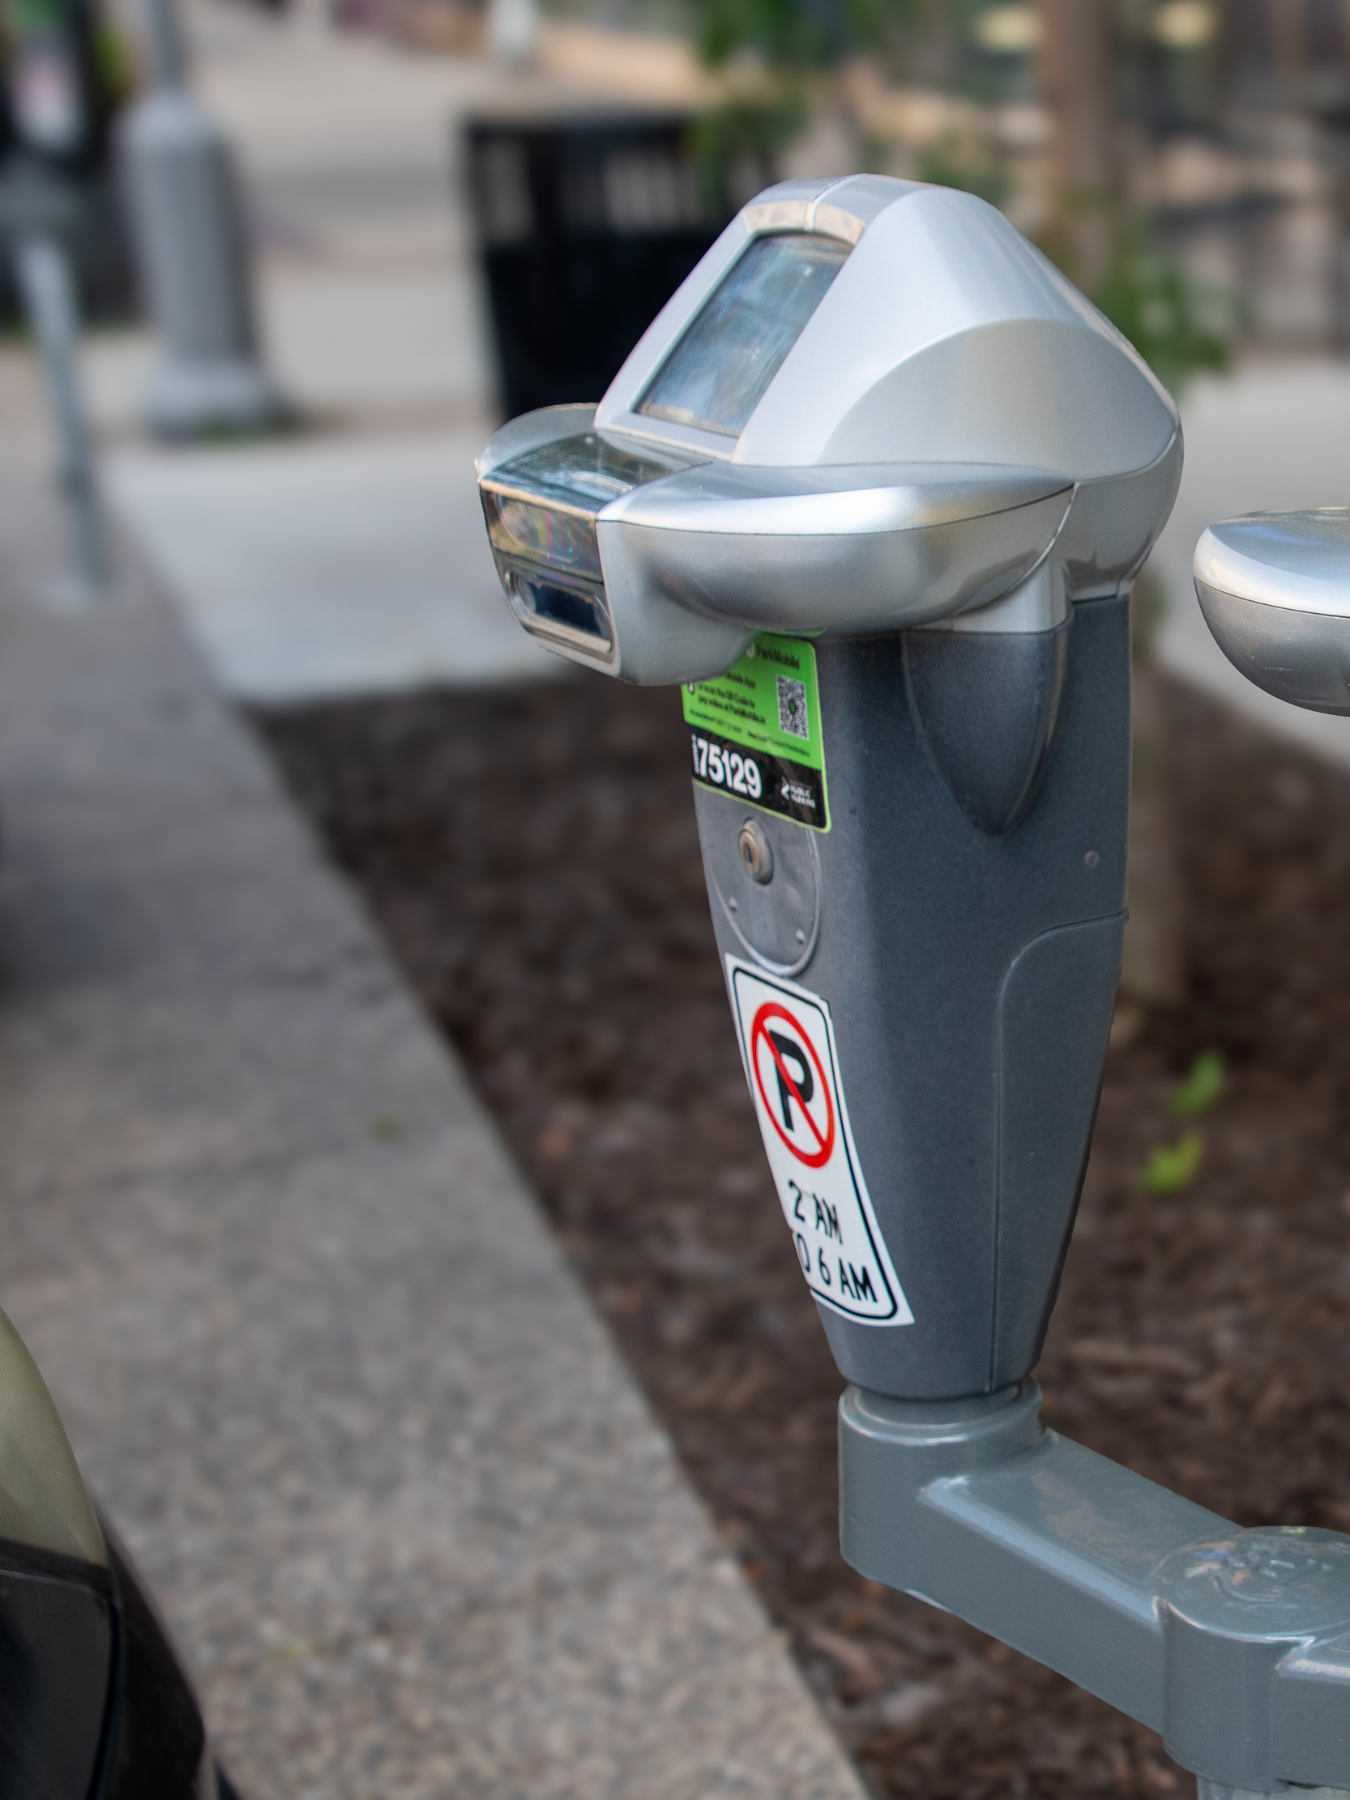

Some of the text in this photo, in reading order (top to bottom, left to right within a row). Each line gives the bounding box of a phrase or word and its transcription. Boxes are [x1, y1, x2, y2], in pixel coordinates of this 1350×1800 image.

[697, 737, 762, 799] 75129
[769, 1029, 814, 1132] P
[788, 1179, 843, 1245] 2 AM
[818, 1245, 831, 1286] 6
[838, 1257, 879, 1303] AM
